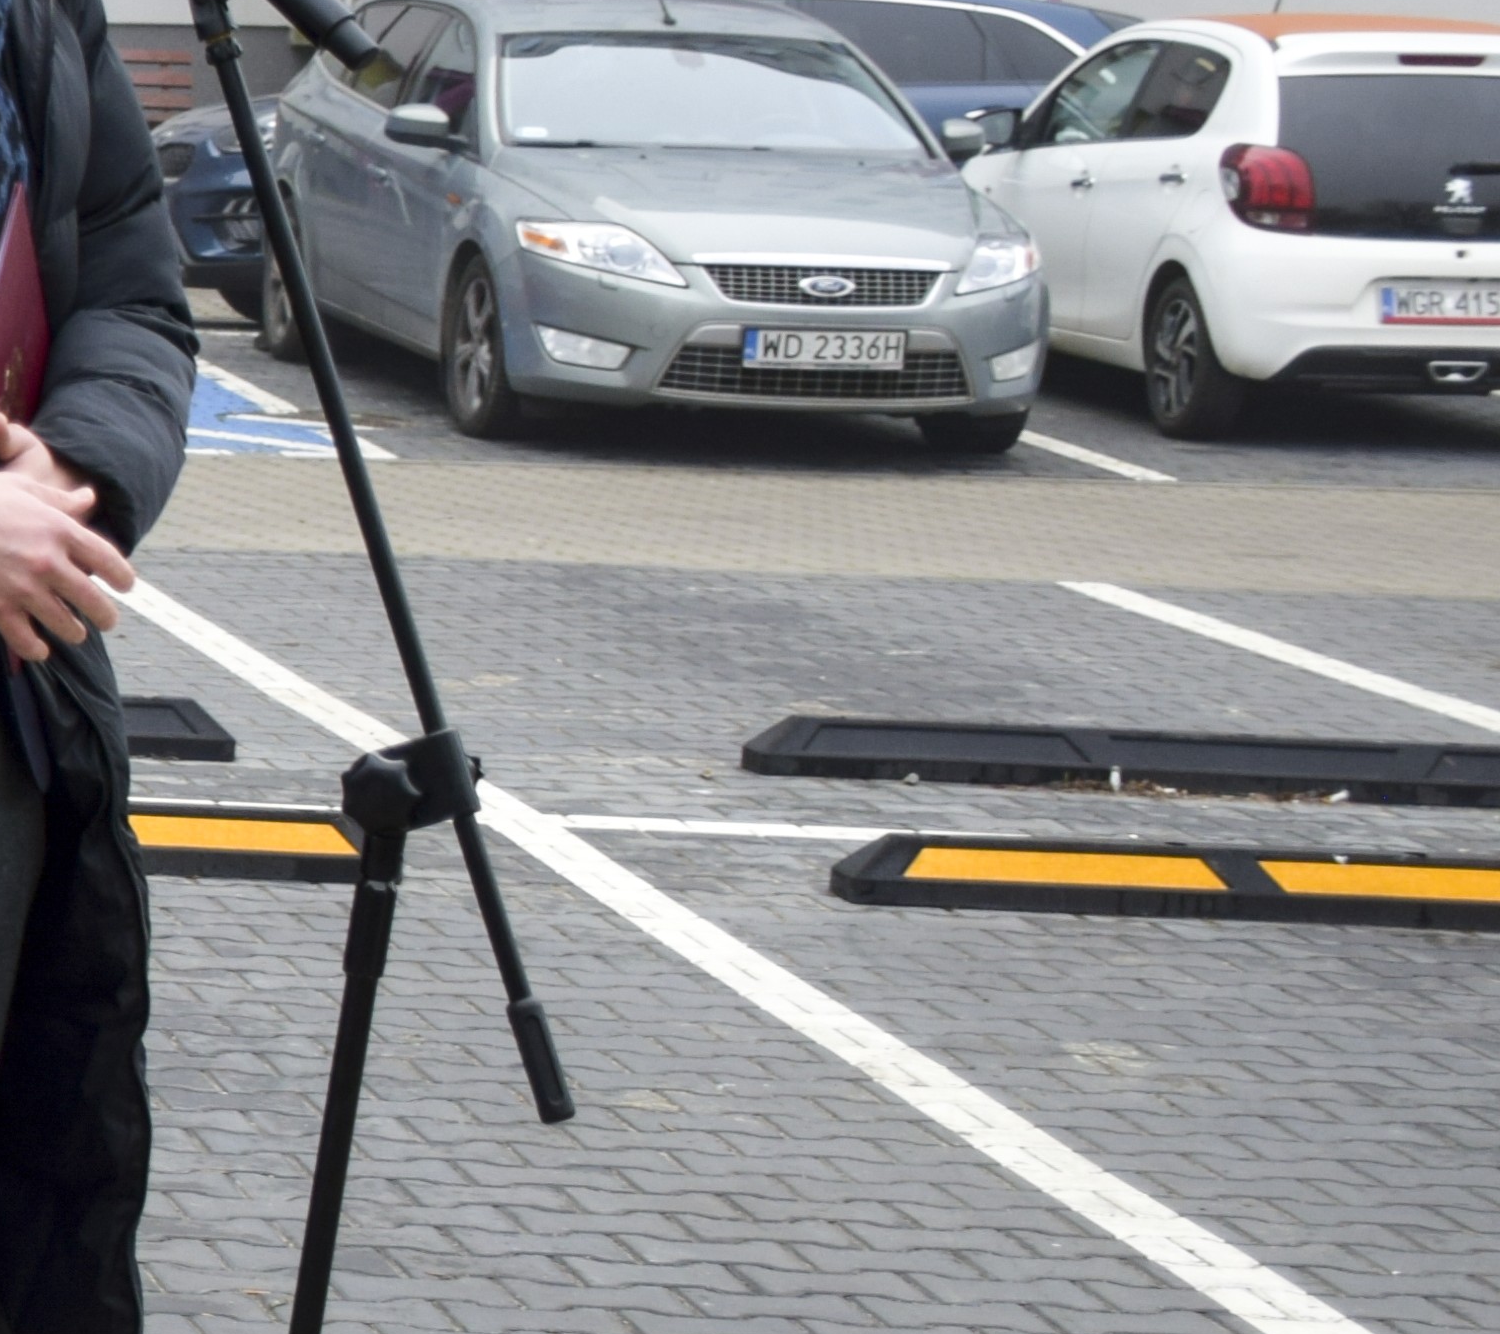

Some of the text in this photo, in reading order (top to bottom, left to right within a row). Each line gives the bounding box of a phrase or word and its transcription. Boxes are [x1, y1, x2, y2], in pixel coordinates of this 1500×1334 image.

[1397, 291, 1500, 316] WGR 415
[763, 333, 804, 359] WD
[814, 334, 902, 361] 2336H
